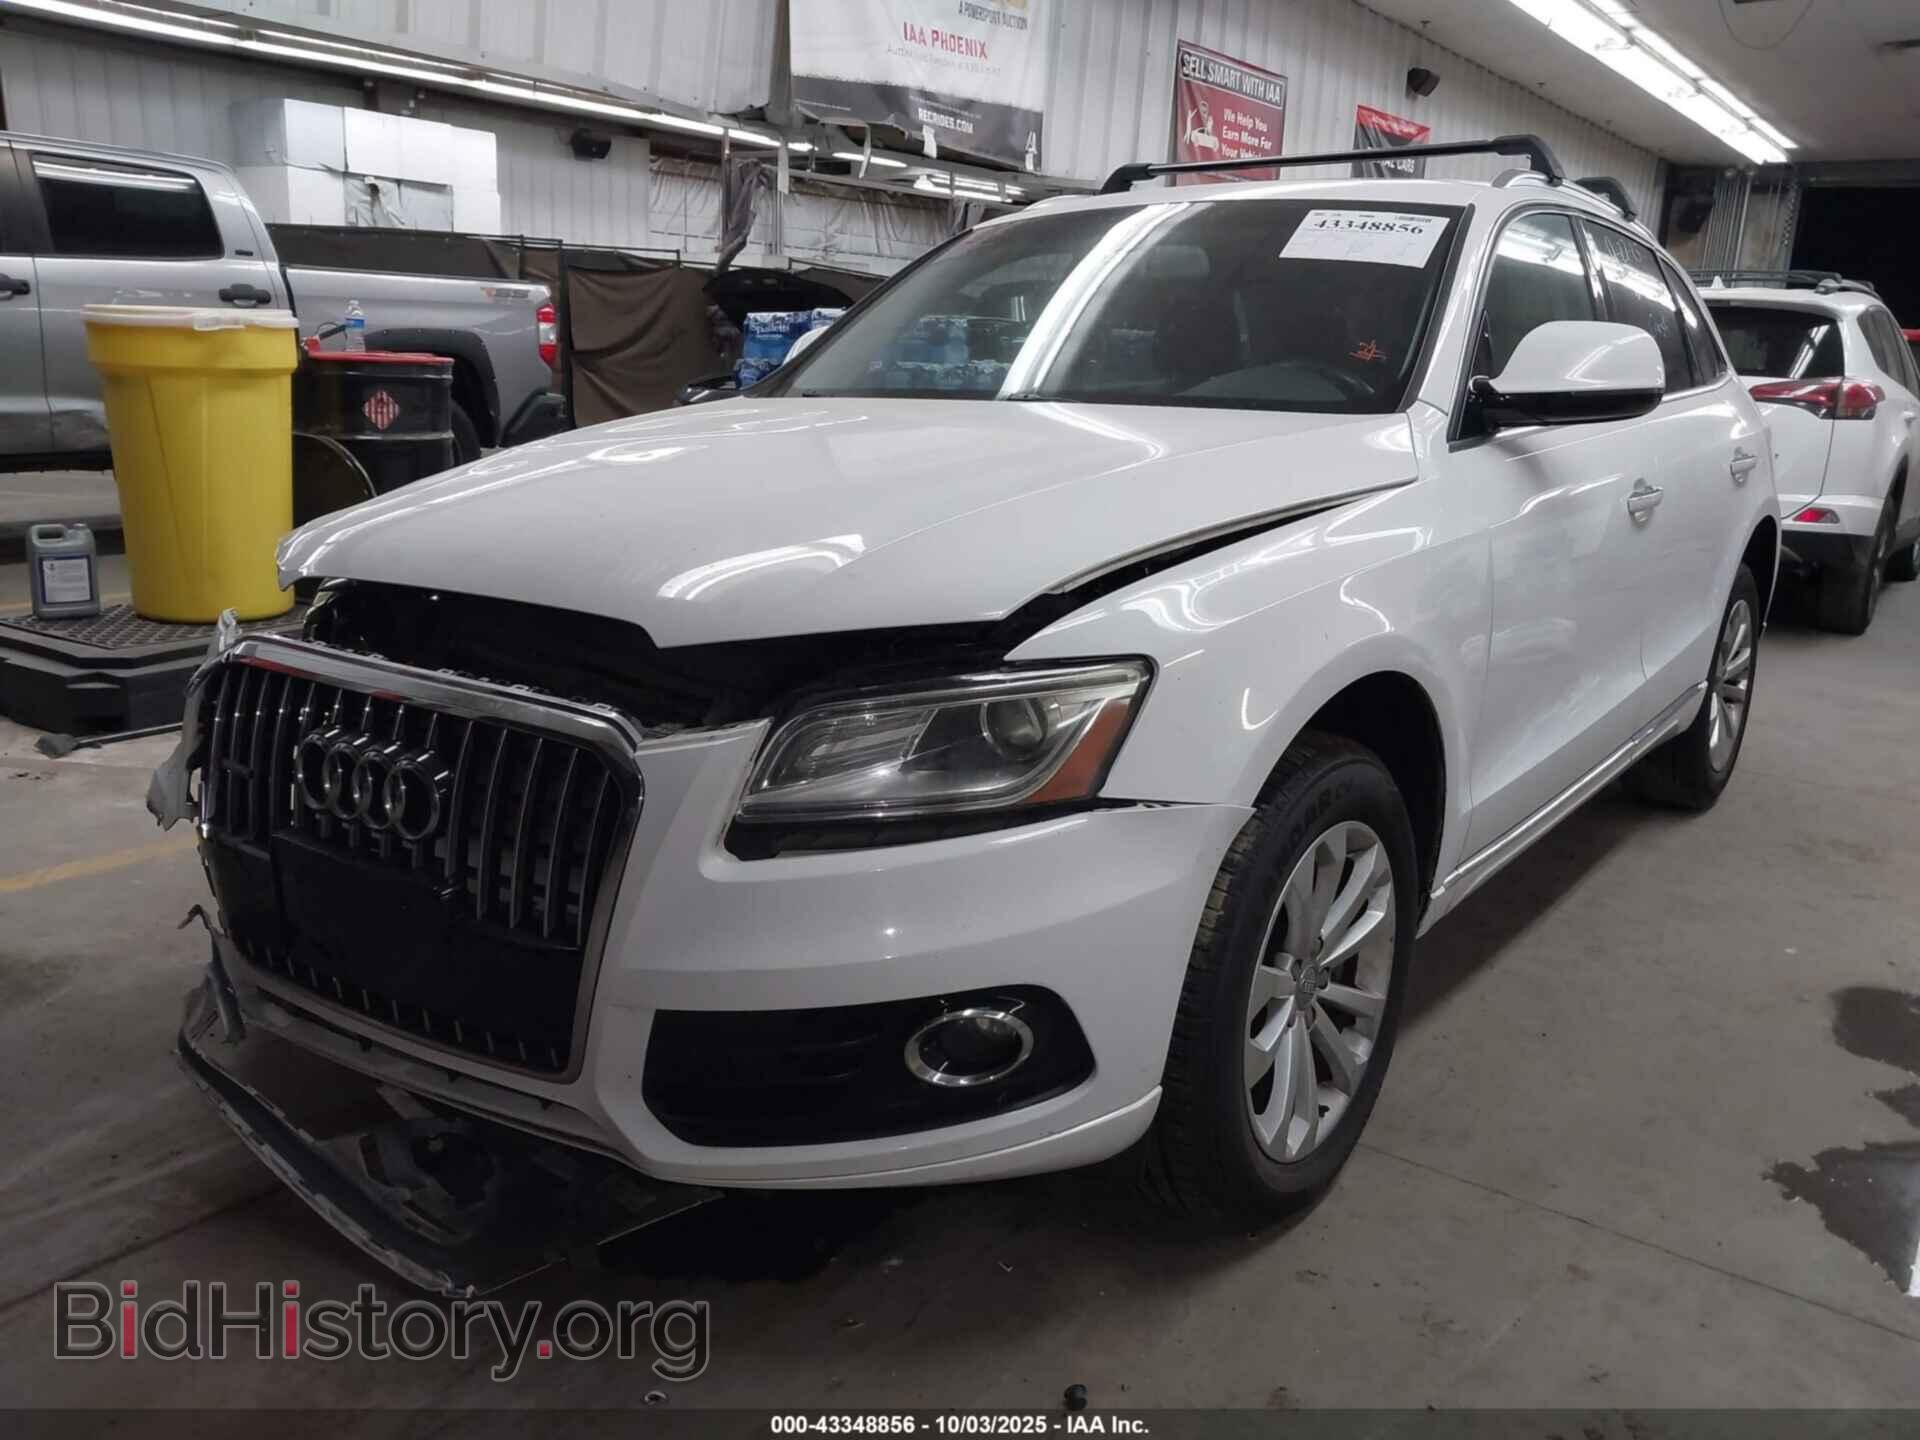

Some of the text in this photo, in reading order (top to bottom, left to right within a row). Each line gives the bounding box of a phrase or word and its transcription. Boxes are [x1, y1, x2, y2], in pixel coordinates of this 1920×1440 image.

[903, 21, 928, 48] IAA
[931, 29, 988, 60] PHOENIX
[1183, 54, 1281, 104] SELL SMART WITH IAA
[1223, 108, 1268, 132] We Help You
[1222, 126, 1272, 150] Earn More For
[1221, 144, 1238, 158] Your
[1313, 219, 1424, 235] 43348856
